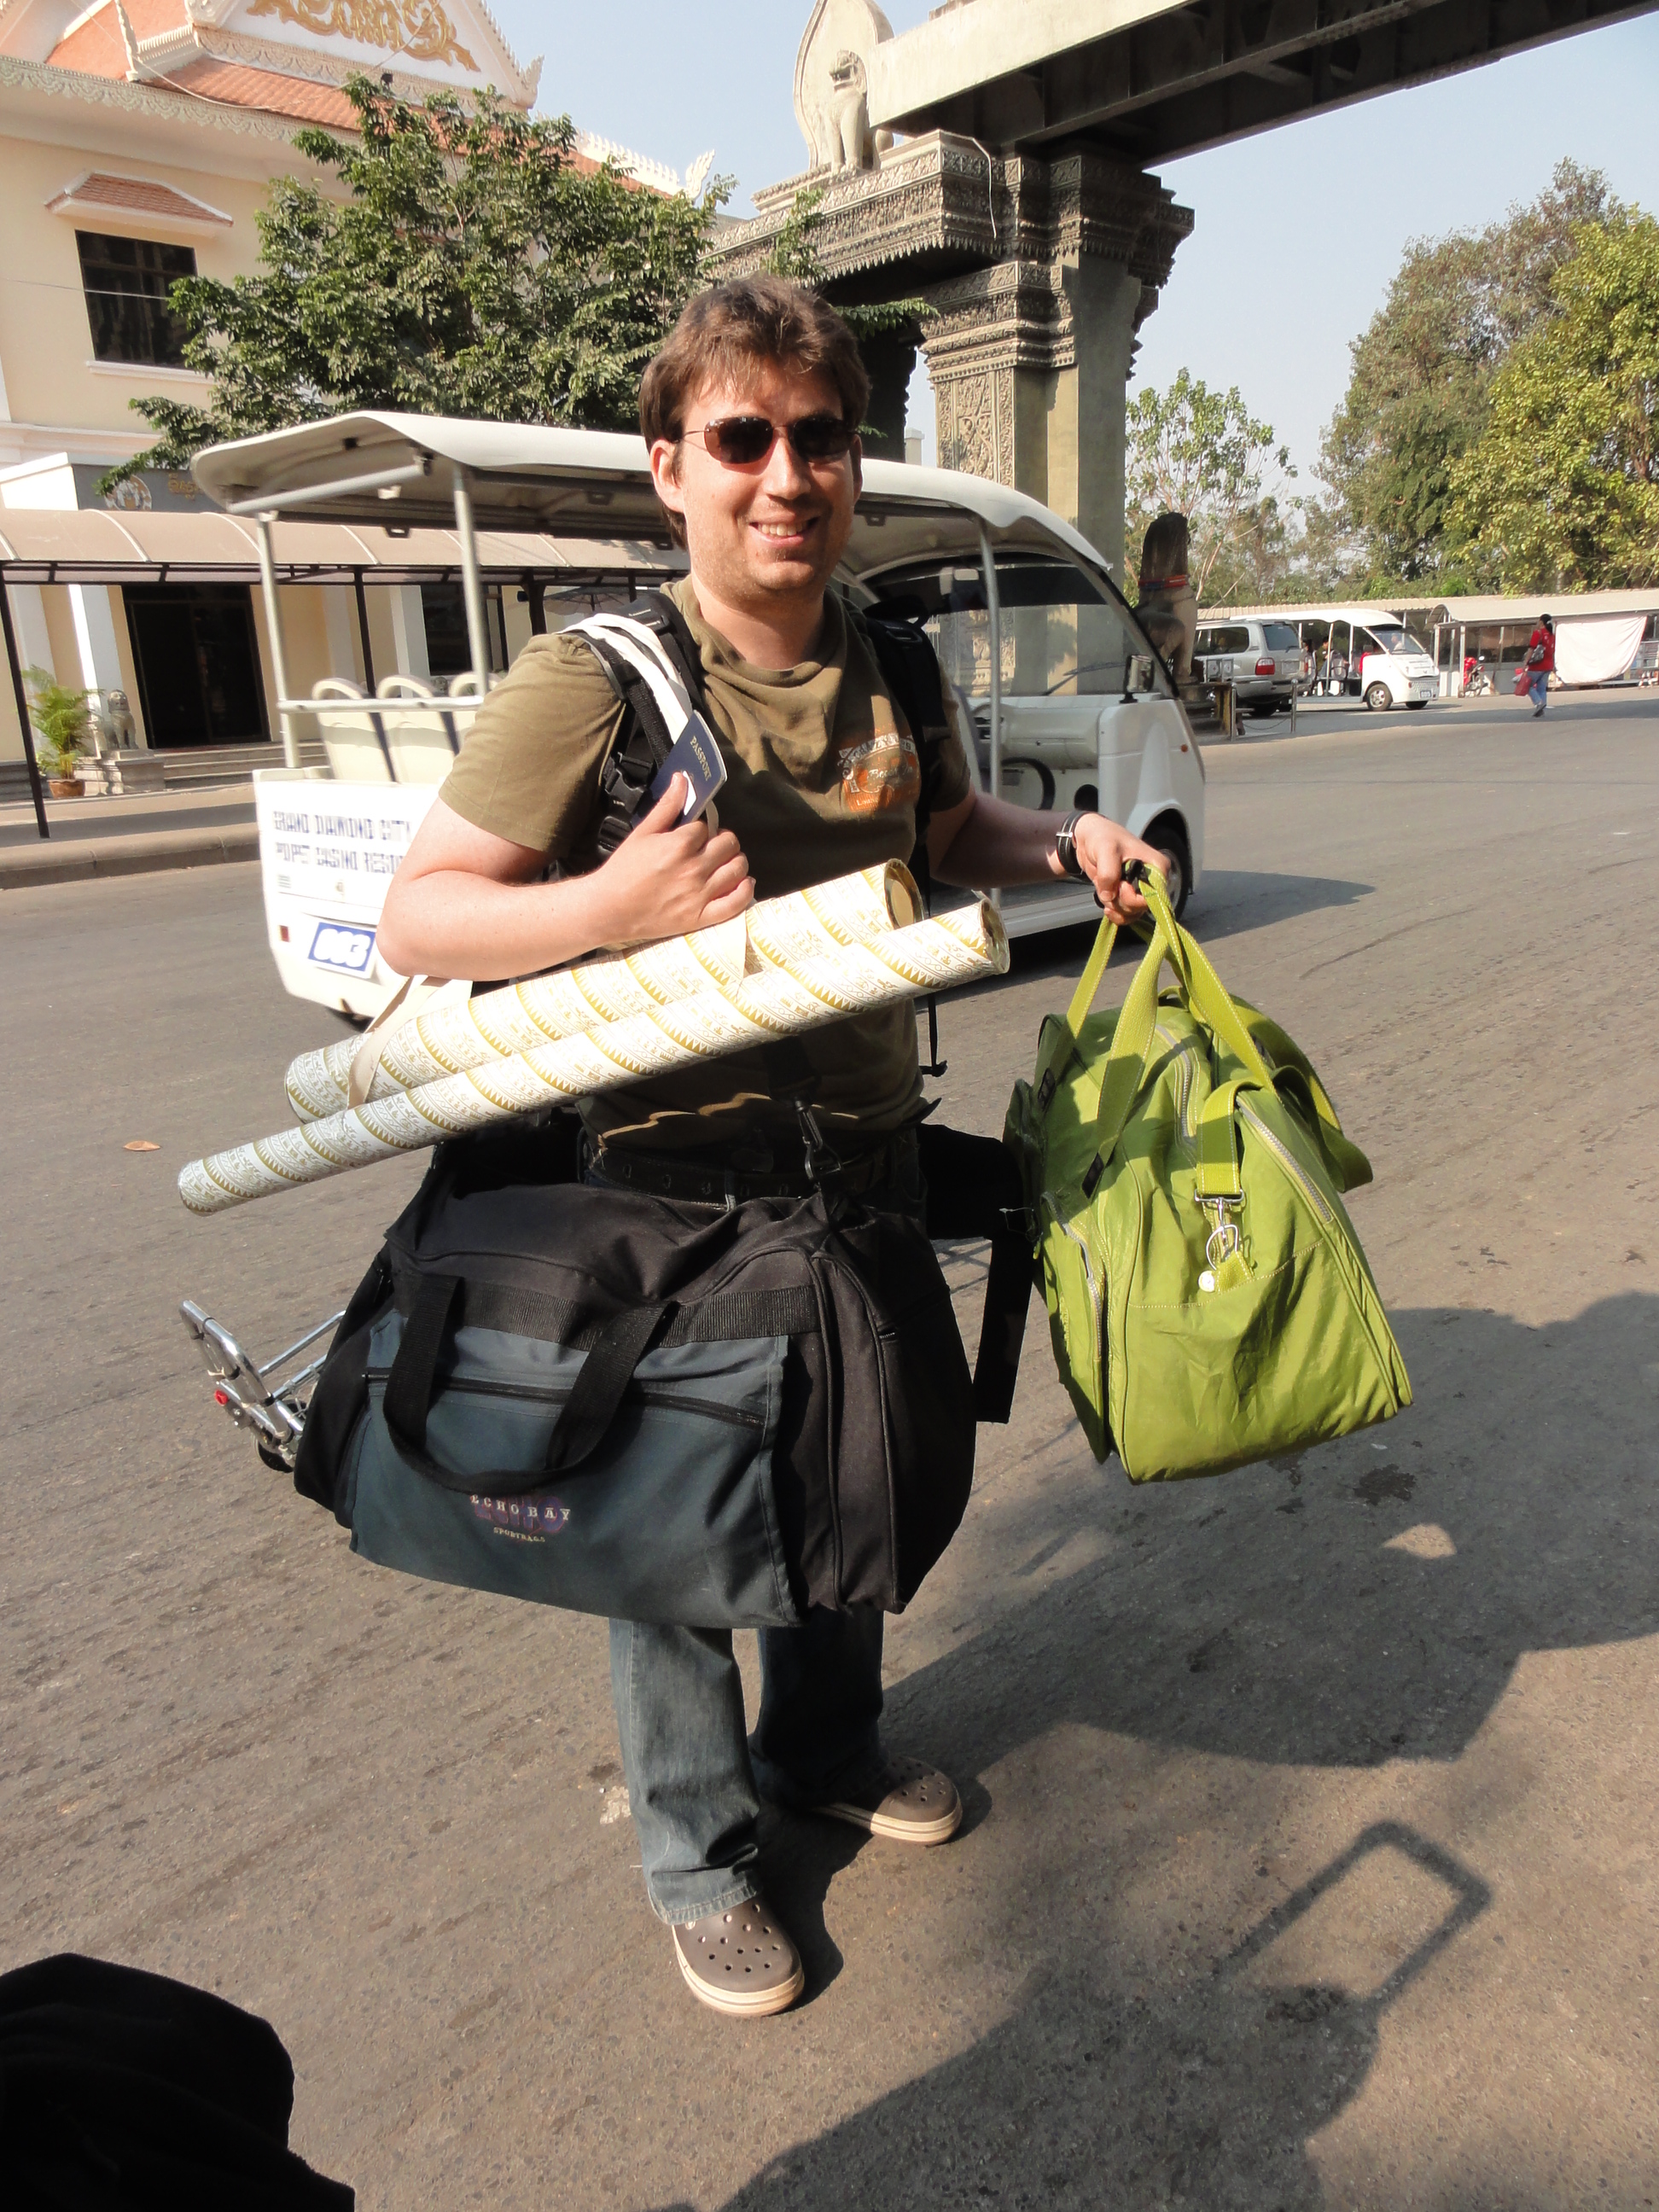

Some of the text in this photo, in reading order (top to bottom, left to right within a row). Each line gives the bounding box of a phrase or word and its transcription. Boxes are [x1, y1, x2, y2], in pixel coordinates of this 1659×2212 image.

[690, 736, 712, 781] PASSPORT
[469, 1494, 571, 1521] ECHO BAY
